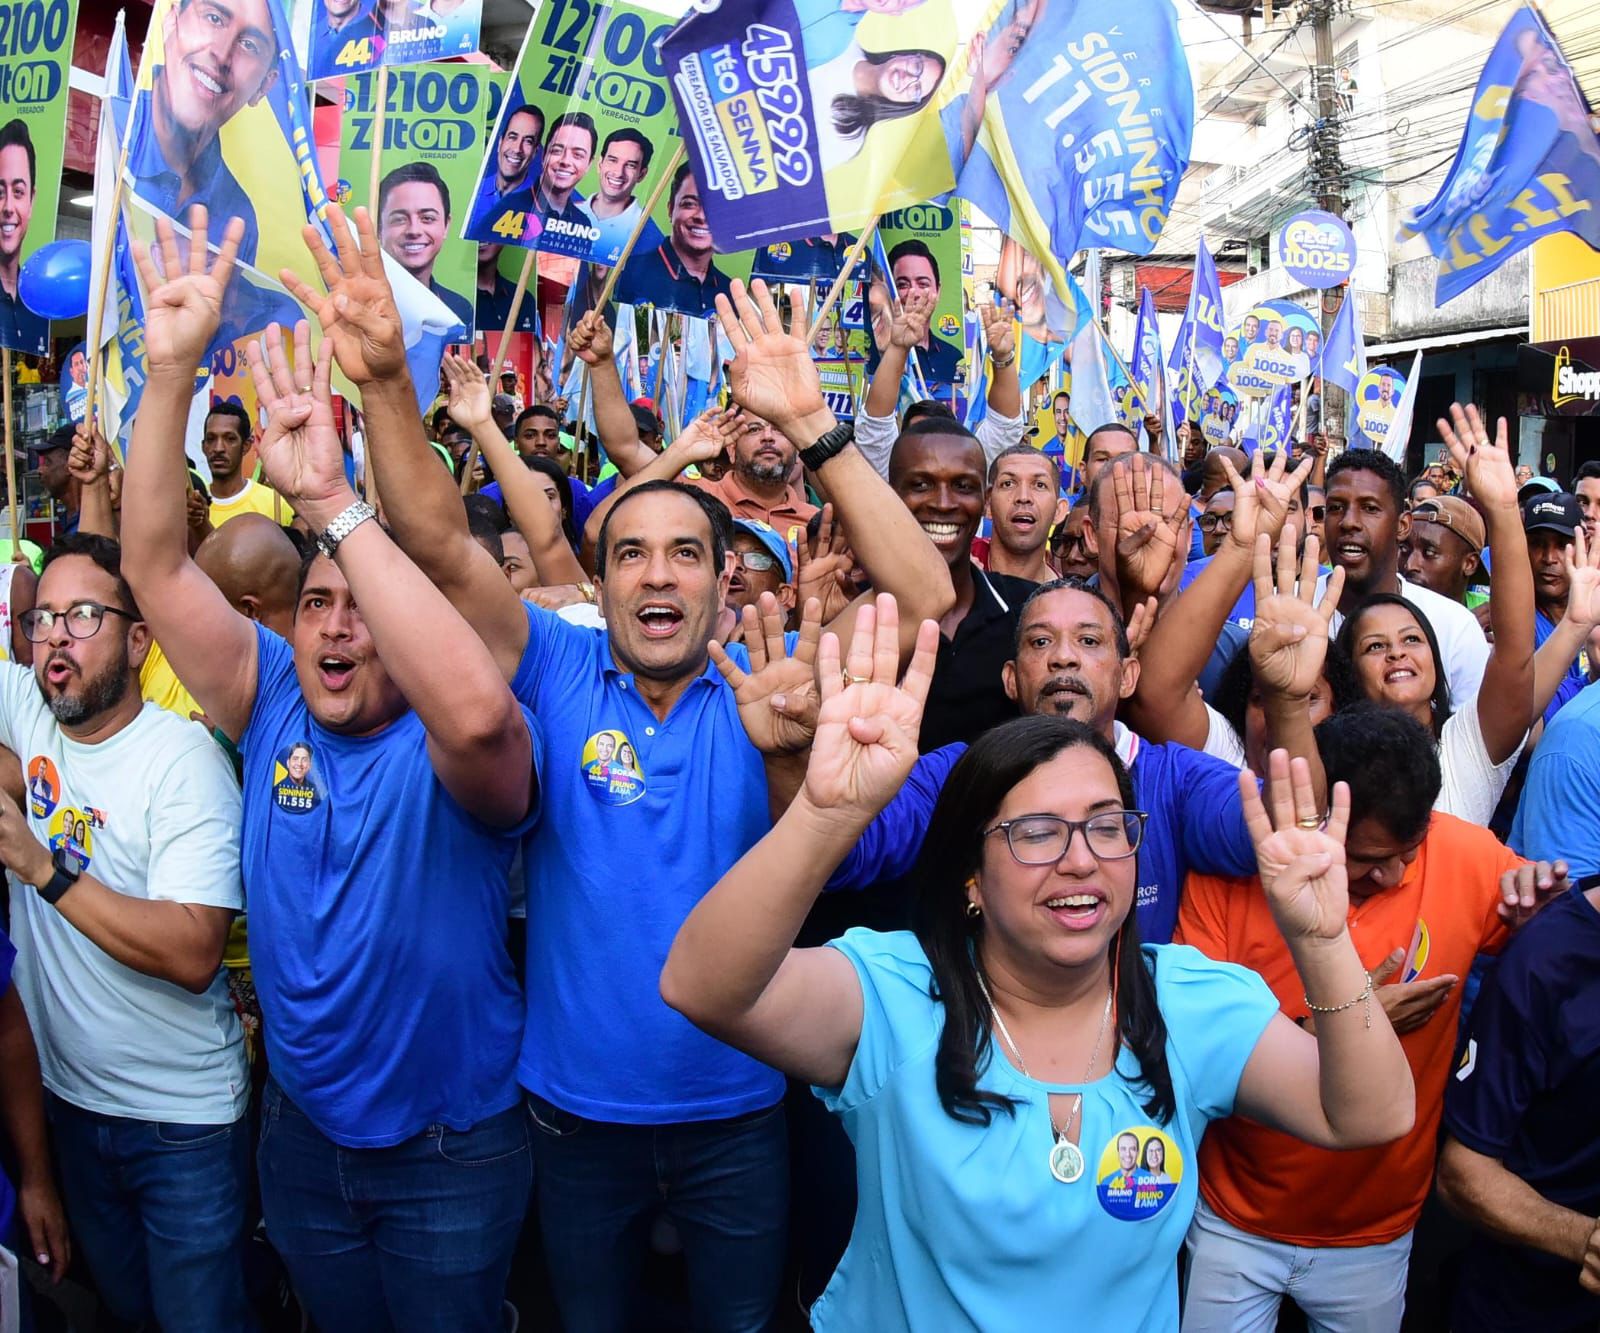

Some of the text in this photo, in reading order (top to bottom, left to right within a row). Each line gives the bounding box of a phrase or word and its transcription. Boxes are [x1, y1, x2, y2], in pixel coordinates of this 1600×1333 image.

[388, 24, 448, 44] BRUNO
[335, 37, 372, 67] 44
[355, 71, 480, 114] 12100
[539, 53, 655, 113] Zilton
[601, 108, 641, 124] VEREADOR
[711, 43, 768, 189] TÉO SENNA
[742, 23, 814, 187] 45999
[350, 118, 463, 150] Zlton
[682, 54, 711, 117] VEREADOR
[708, 132, 739, 197] SALVADOR
[1067, 32, 1168, 243] SIDNINHO
[491, 209, 526, 238] 44
[545, 217, 601, 241] BRUNO
[567, 244, 594, 256] PAULA
[1284, 246, 1350, 272] 10025
[1253, 358, 1296, 378] 10025
[278, 787, 314, 799] SIDNINHO
[278, 795, 313, 809] 11.555
[1107, 1188, 1133, 1197] BRUNO
[1138, 1176, 1160, 1185] BORA
[1136, 1191, 1164, 1200] BRUNO
[1141, 1199, 1159, 1208] ANA
